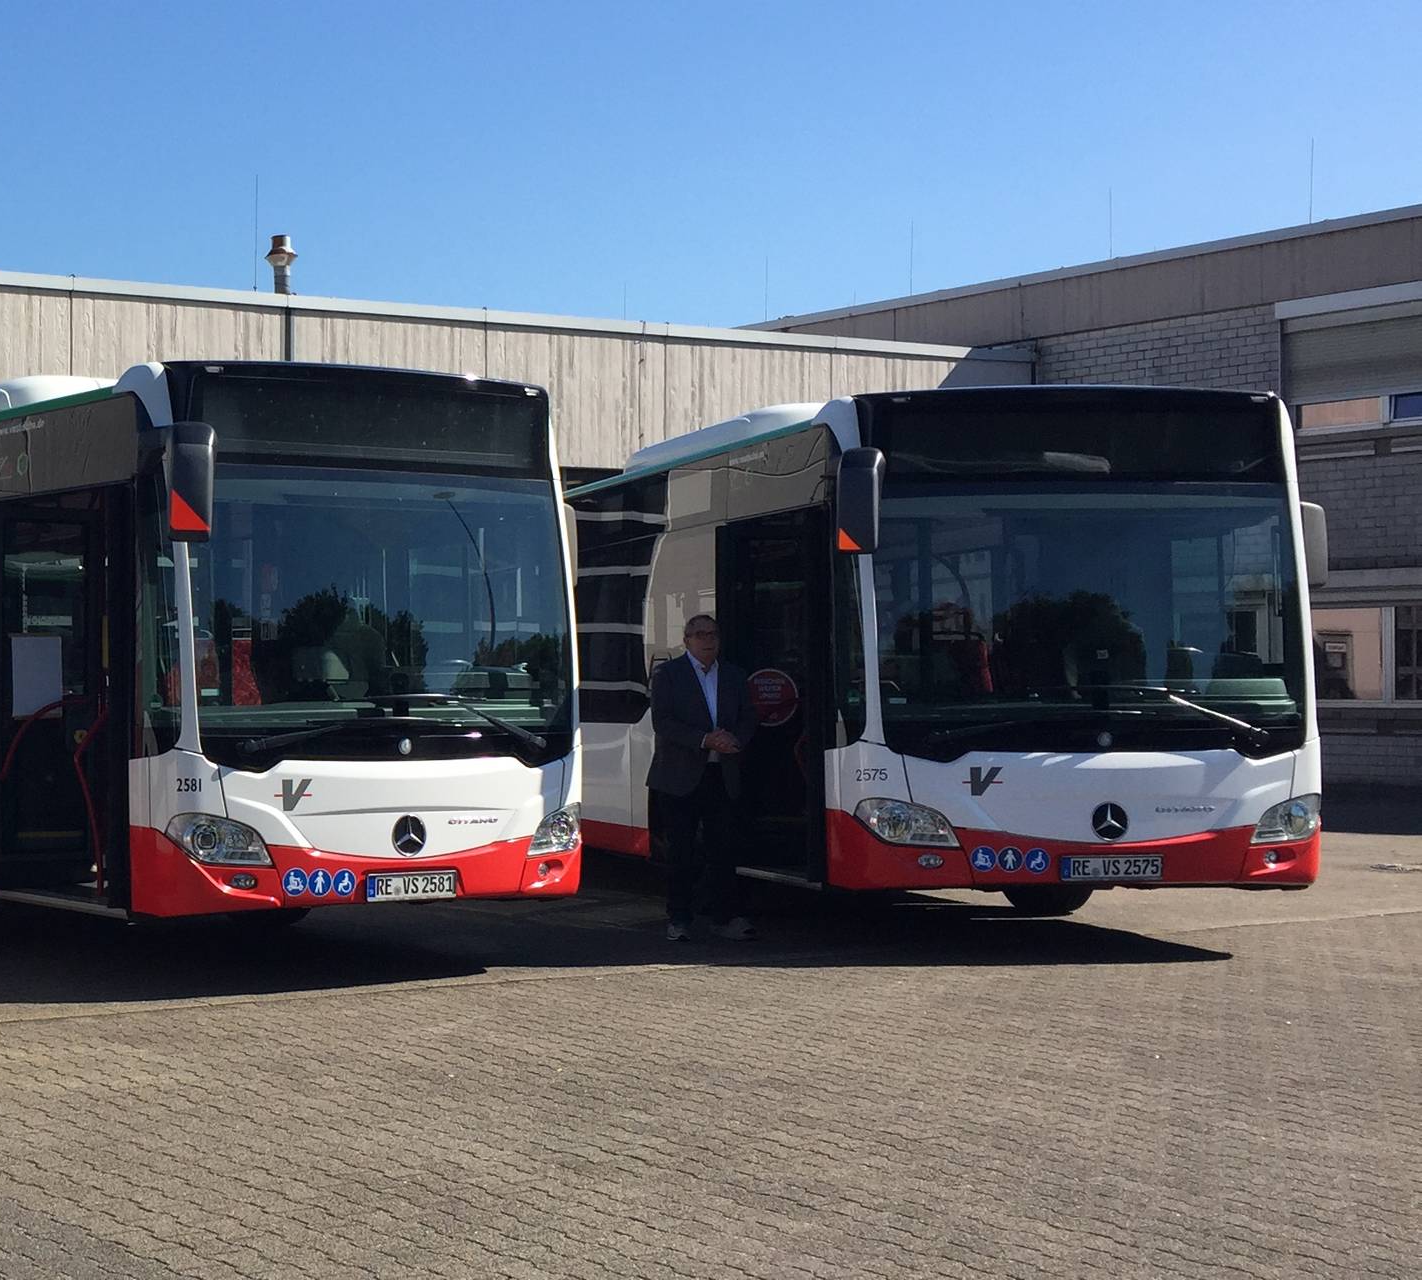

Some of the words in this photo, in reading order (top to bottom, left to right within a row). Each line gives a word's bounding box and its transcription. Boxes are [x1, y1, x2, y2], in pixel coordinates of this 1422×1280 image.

[855, 768, 889, 782] 2575
[176, 778, 203, 793] 2581
[1072, 860, 1091, 876] RE
[1102, 859, 1121, 876] VS
[1123, 858, 1160, 875] 2575
[376, 878, 392, 896] RE
[403, 877, 419, 894] VS
[422, 875, 453, 894] 2581
